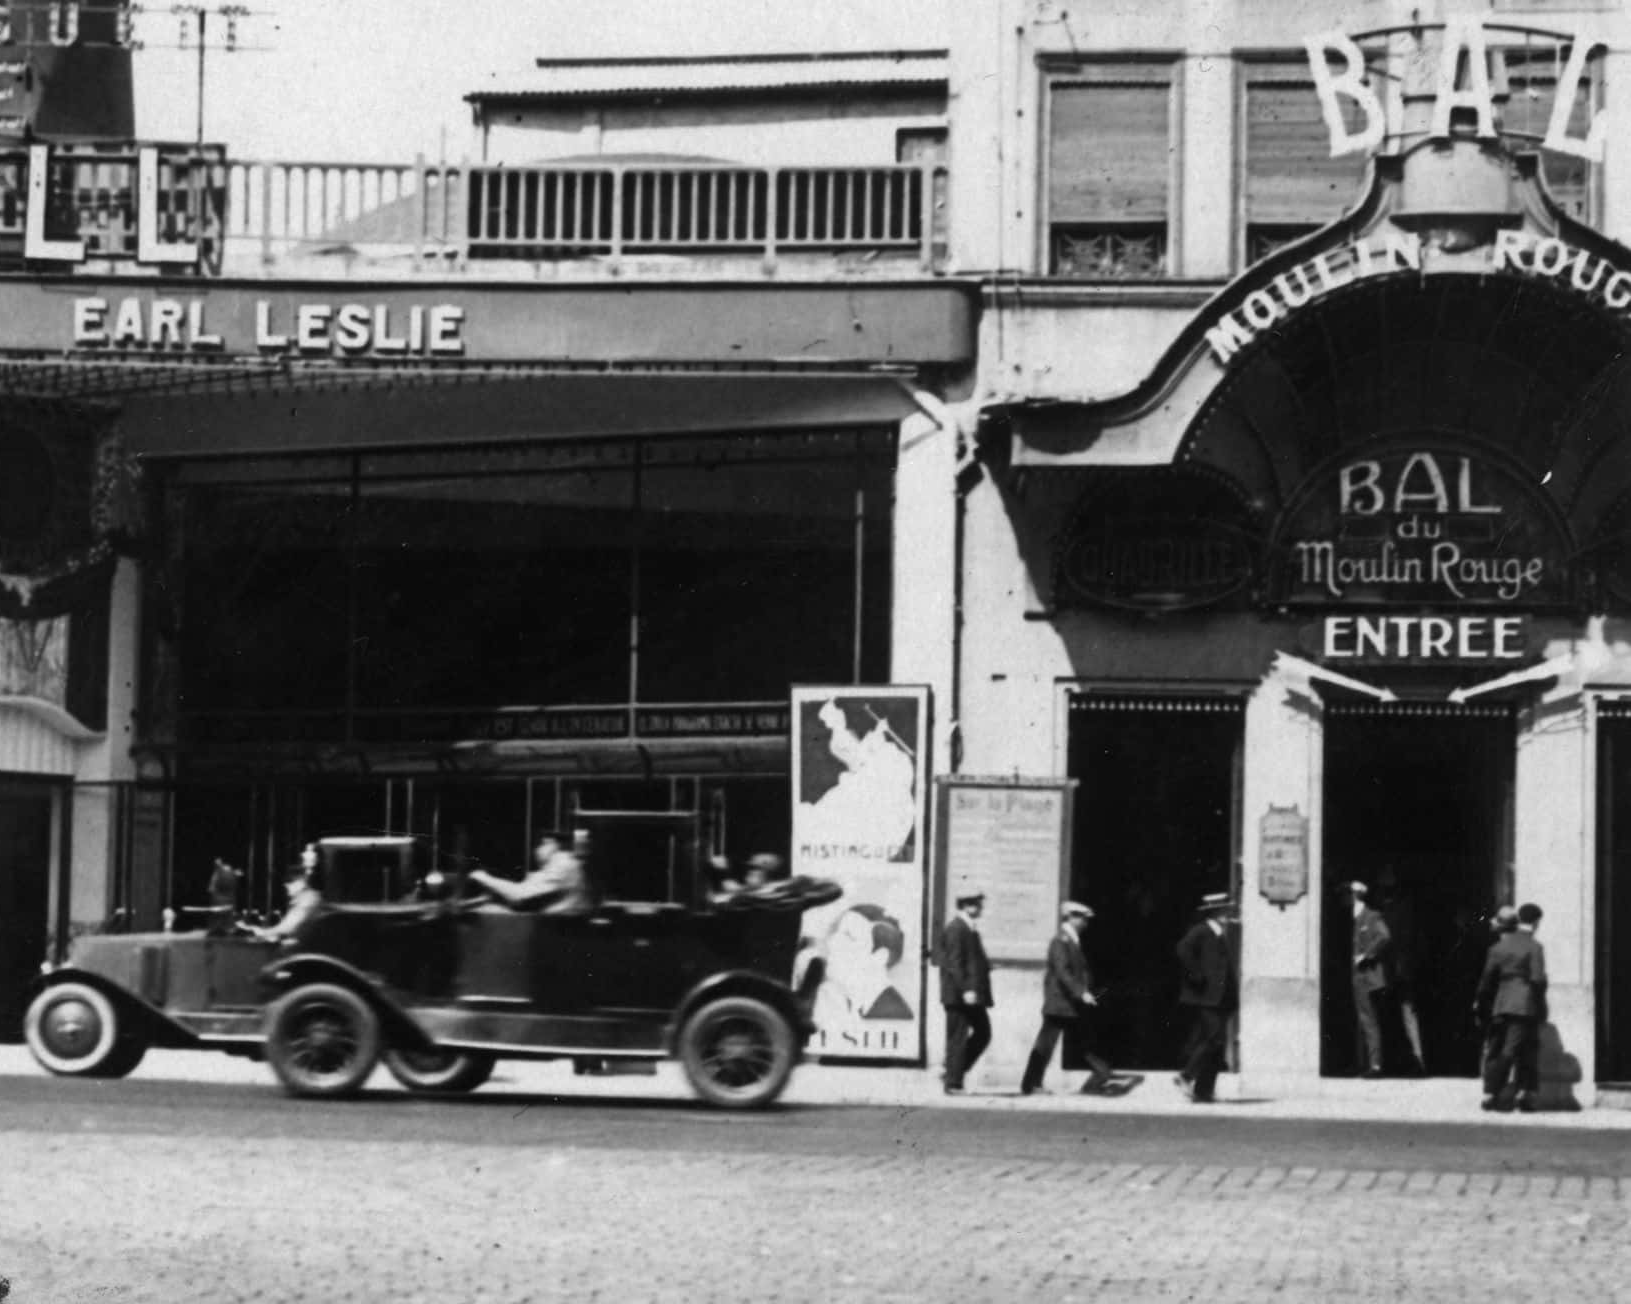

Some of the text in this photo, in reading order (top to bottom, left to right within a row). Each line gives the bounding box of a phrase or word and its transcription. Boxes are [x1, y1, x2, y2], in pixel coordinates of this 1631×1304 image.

[1303, 14, 1609, 163] BAL
[73, 296, 466, 357] EARL LESLIE
[1205, 230, 1421, 364] MOULIN
[1339, 452, 1502, 514] BAL
[1397, 514, 1440, 538] du
[1295, 541, 1544, 600] Moulin Rouge
[1324, 616, 1524, 658] ENTREE
